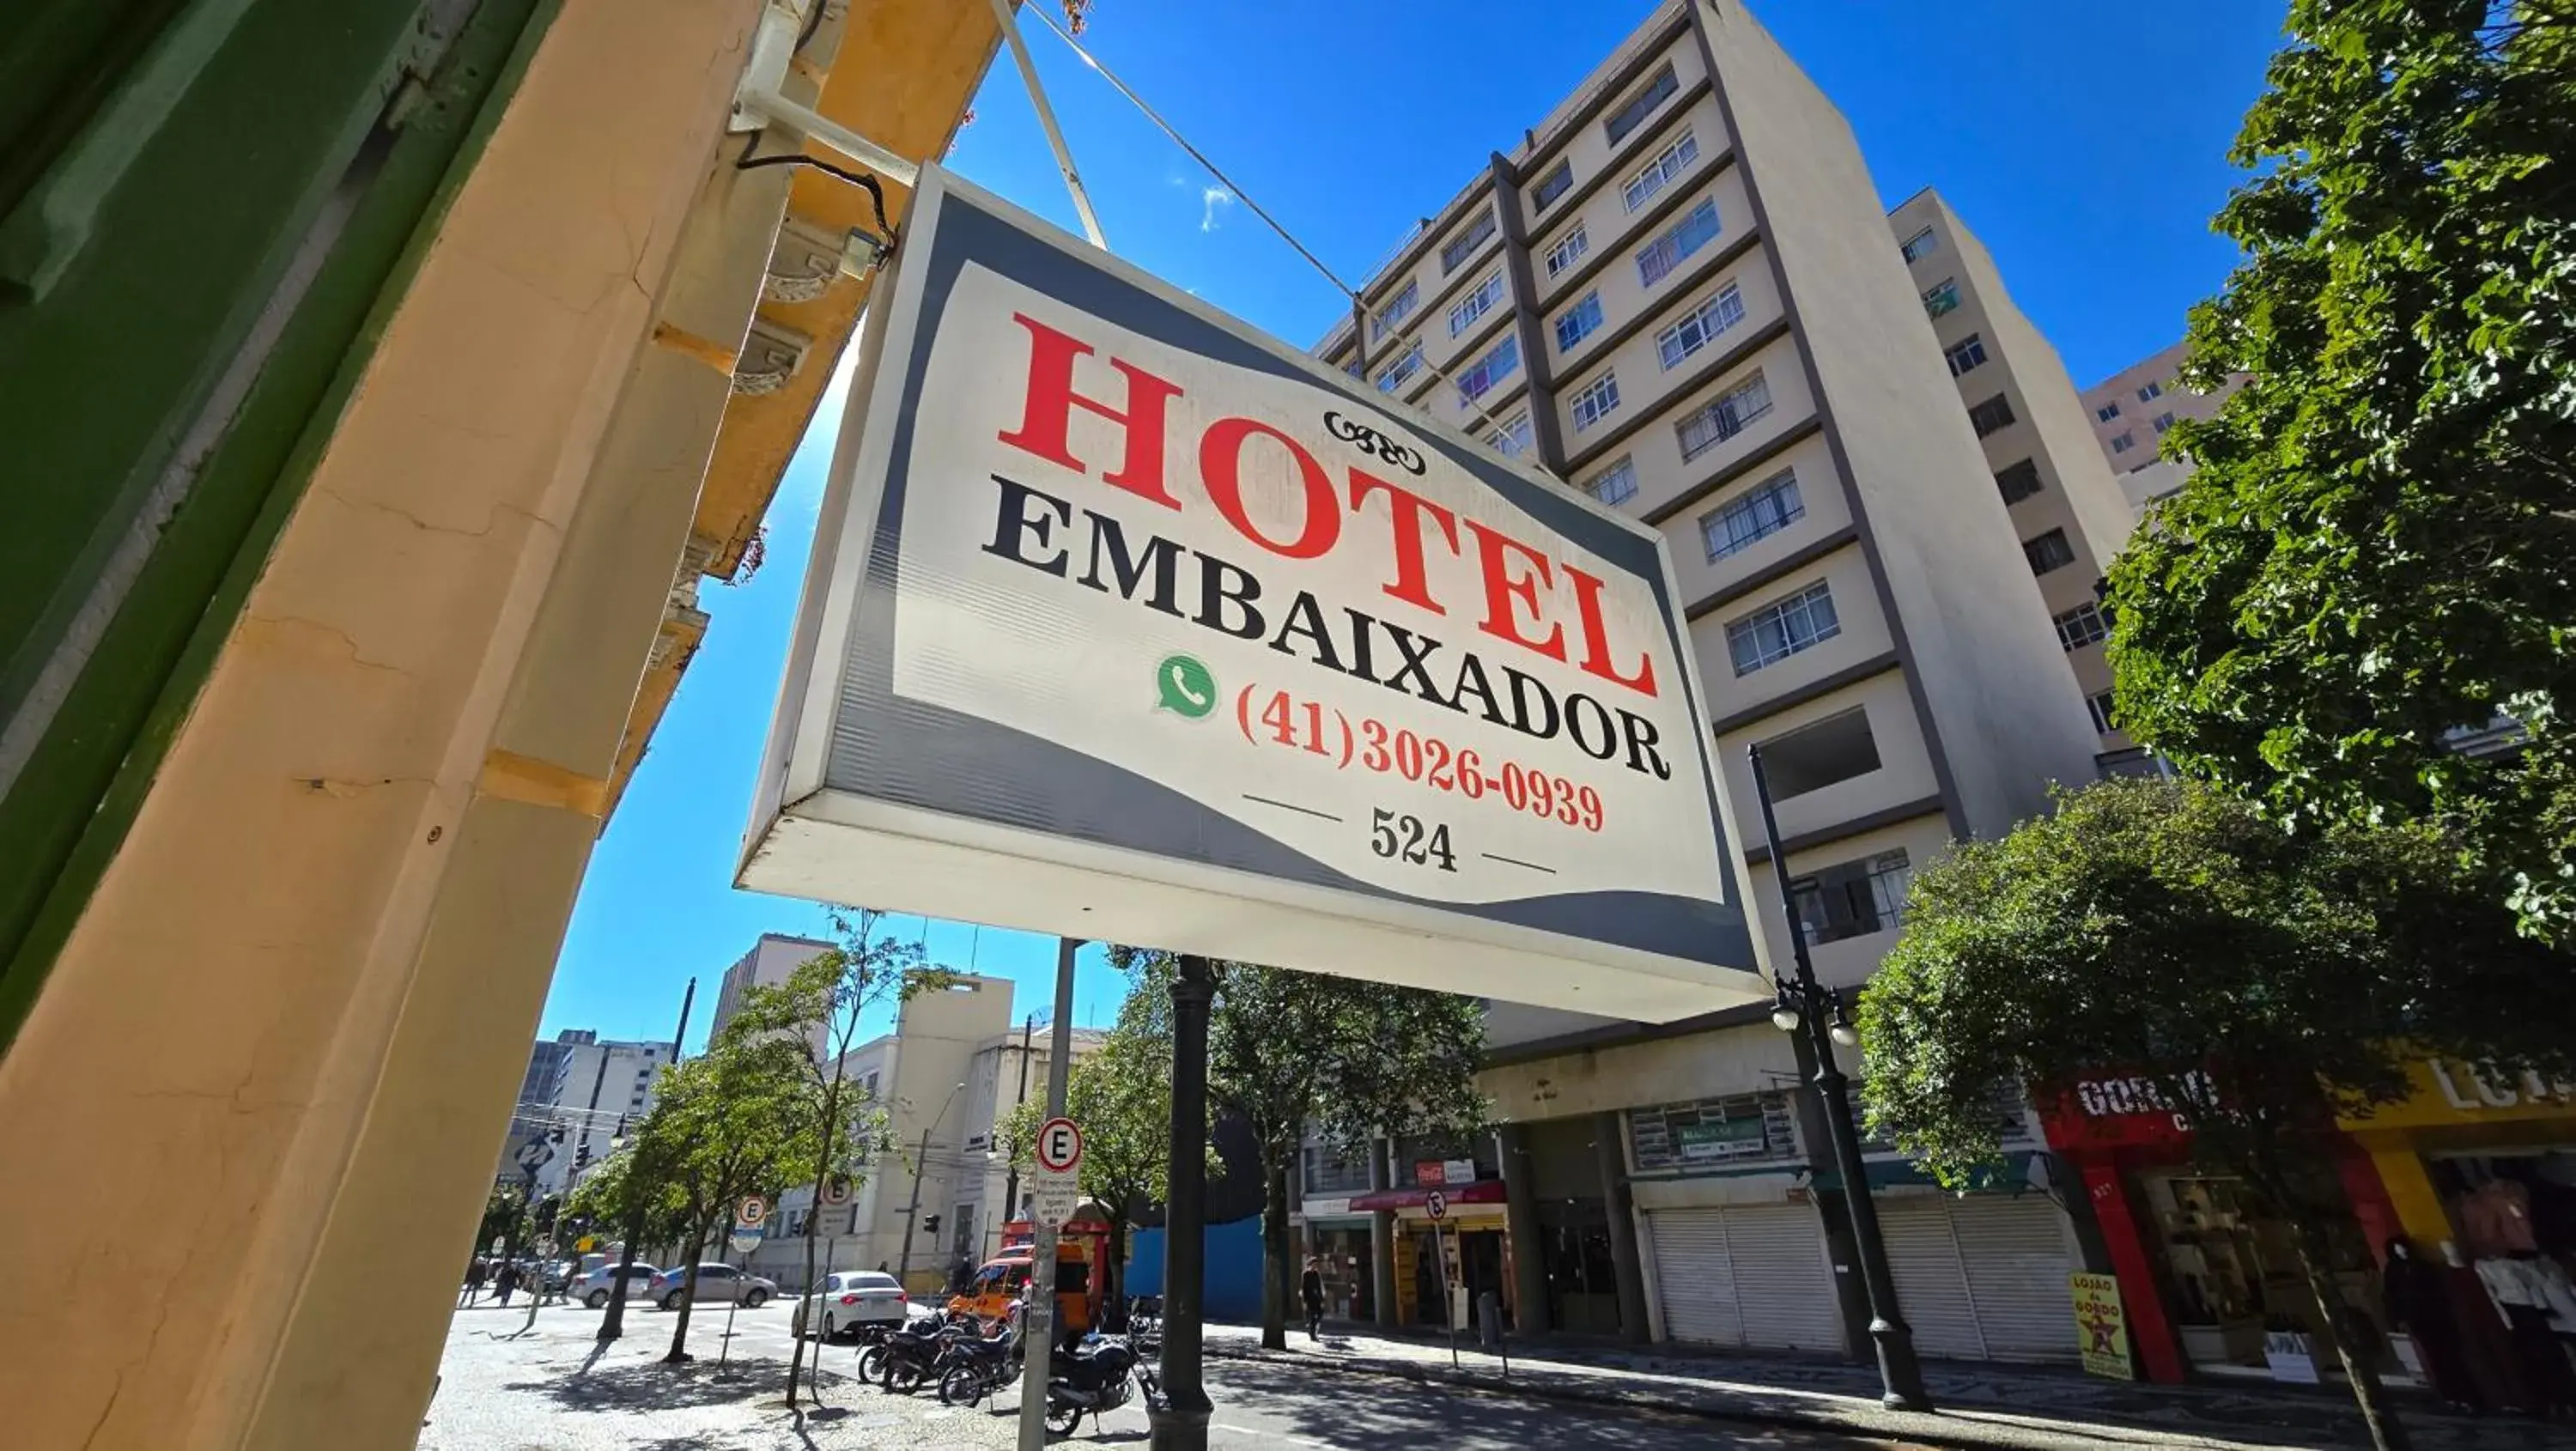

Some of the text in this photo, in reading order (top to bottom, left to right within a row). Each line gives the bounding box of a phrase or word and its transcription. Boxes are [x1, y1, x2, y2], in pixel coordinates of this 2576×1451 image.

[998, 311, 1658, 697] HOTEL
[981, 474, 1672, 781] EMBAIXADOR
[1237, 683, 1603, 833] (41)3026-0939
[1371, 806, 1457, 873] 524
[1052, 1131, 1068, 1158] E
[748, 1203, 757, 1218] E
